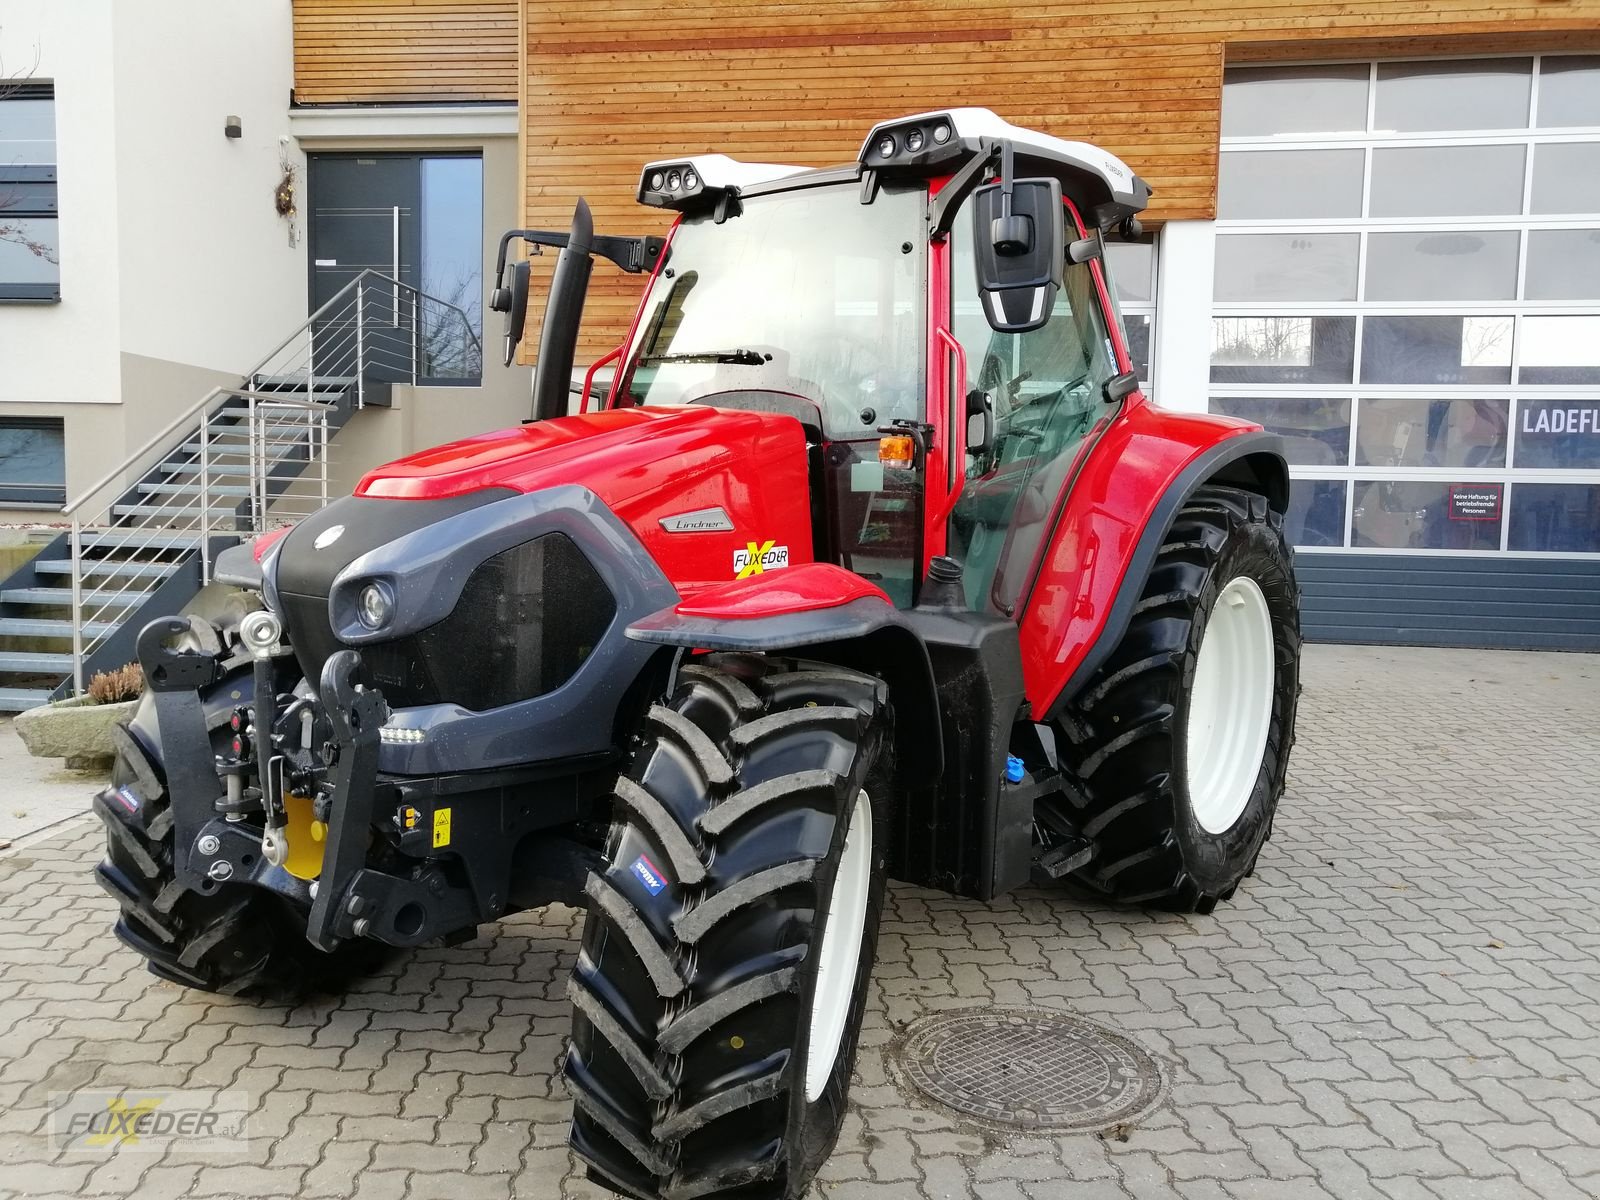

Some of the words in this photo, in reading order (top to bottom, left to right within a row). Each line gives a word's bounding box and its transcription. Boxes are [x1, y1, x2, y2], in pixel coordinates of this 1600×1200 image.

[1523, 409, 1600, 433] LADEFL
[676, 520, 724, 529] Lindner
[735, 550, 788, 567] FLIXEDER
[635, 862, 660, 887] Mitas
